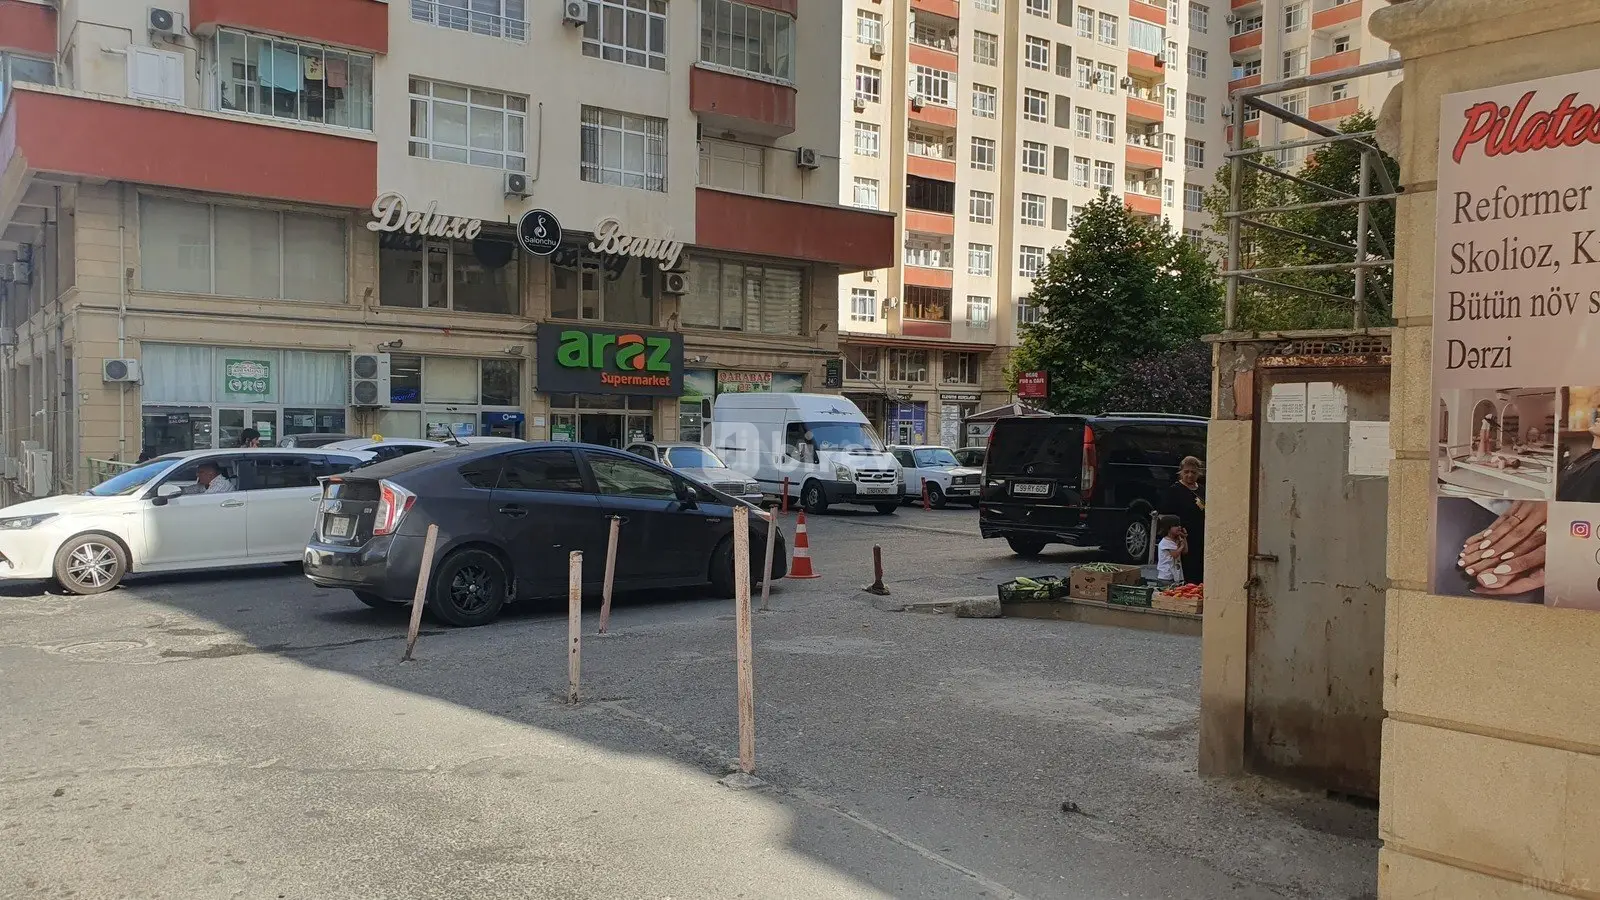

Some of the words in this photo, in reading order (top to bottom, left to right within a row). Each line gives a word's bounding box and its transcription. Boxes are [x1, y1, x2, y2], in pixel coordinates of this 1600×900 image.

[366, 191, 482, 240] Deluxe
[1452, 184, 1593, 225] Reformer
[524, 235, 557, 246] Salonchu
[587, 216, 684, 271] Beauty
[1450, 236, 1560, 275] Skolioz,
[1570, 230, 1600, 265] K
[1447, 290, 1522, 322] Bütün
[1530, 286, 1580, 317] növ
[557, 331, 671, 372] araz
[1445, 335, 1513, 370] Dərzi
[601, 371, 671, 387] Supermarket
